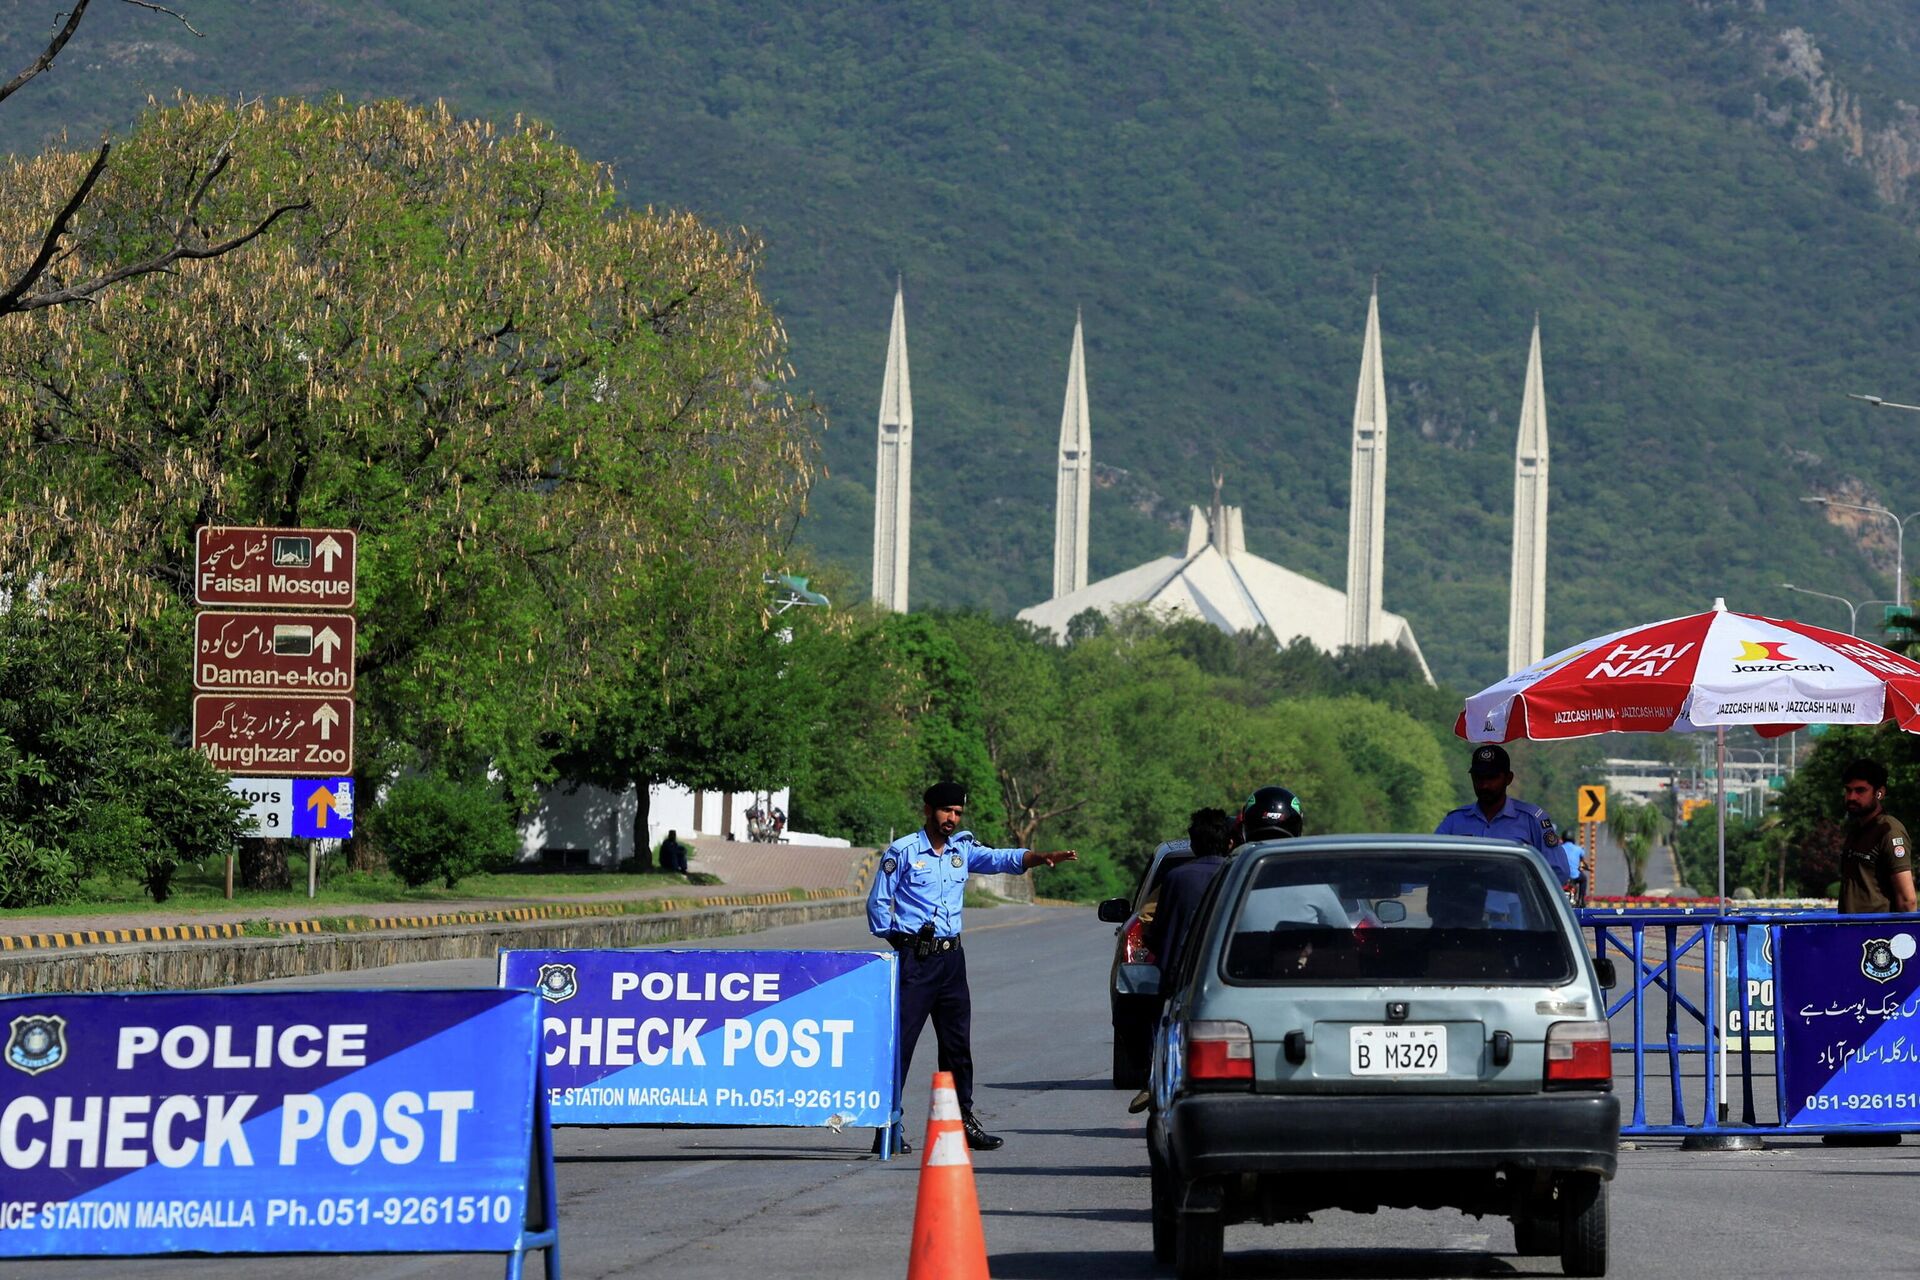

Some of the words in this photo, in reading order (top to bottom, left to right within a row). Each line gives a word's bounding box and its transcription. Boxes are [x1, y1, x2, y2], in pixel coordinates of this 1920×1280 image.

[201, 573, 261, 593] Faisal
[268, 574, 350, 599] Mosque
[1605, 642, 1695, 660] HAI
[202, 663, 348, 687] Daman-e-koh
[1585, 660, 1676, 679] NA!
[1731, 663, 1835, 673] JazzCash
[1554, 708, 1590, 724] JAZZCASH
[1591, 708, 1604, 720] HAI
[1605, 708, 1616, 719] NA
[1717, 702, 1752, 715] JAZZCASH
[1754, 702, 1767, 712] HAI
[1768, 701, 1779, 712] NA
[1785, 701, 1825, 713] JAZZCASH
[1826, 702, 1840, 713] HAI
[1841, 703, 1856, 714] NA!
[201, 743, 300, 766] Murghzar
[304, 744, 346, 763] Zoo
[611, 972, 780, 1002] POLICE
[117, 1024, 368, 1070] POLICE
[543, 1017, 708, 1067] CHECK
[723, 1018, 854, 1068] POST
[1358, 1045, 1371, 1069] B
[1385, 1044, 1438, 1069] M329
[564, 1087, 625, 1106] STATION
[627, 1087, 709, 1106] MARGALLA
[716, 1087, 881, 1110] Ph.051-9261510
[1806, 1093, 1920, 1110] 051-926151
[0, 1094, 258, 1170] CHECK
[279, 1090, 474, 1166] POST
[0, 1201, 37, 1230] ICE
[40, 1200, 130, 1230] STATION
[135, 1199, 256, 1229] MARGALLA
[265, 1194, 512, 1227] Ph.051-9261510
